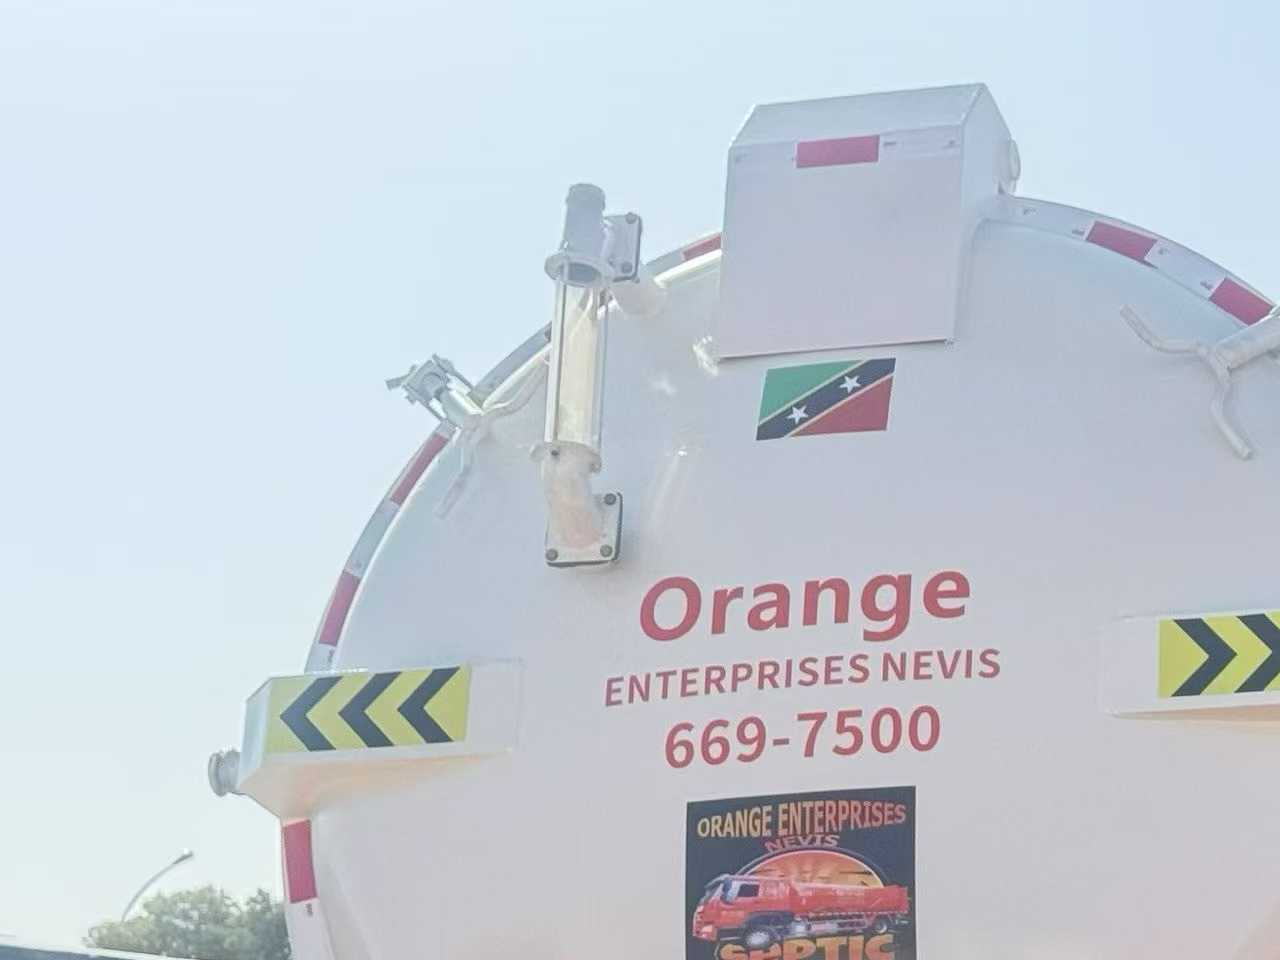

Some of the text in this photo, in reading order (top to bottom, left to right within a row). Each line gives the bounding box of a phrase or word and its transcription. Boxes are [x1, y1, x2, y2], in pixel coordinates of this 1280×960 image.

[638, 569, 971, 642] Orange
[604, 648, 1001, 707] ENTERPRISES NEVIS
[664, 705, 941, 769] 669-7500
[697, 799, 907, 838] ORANGE ENTERPRISES
[764, 834, 841, 854] NEVIS
